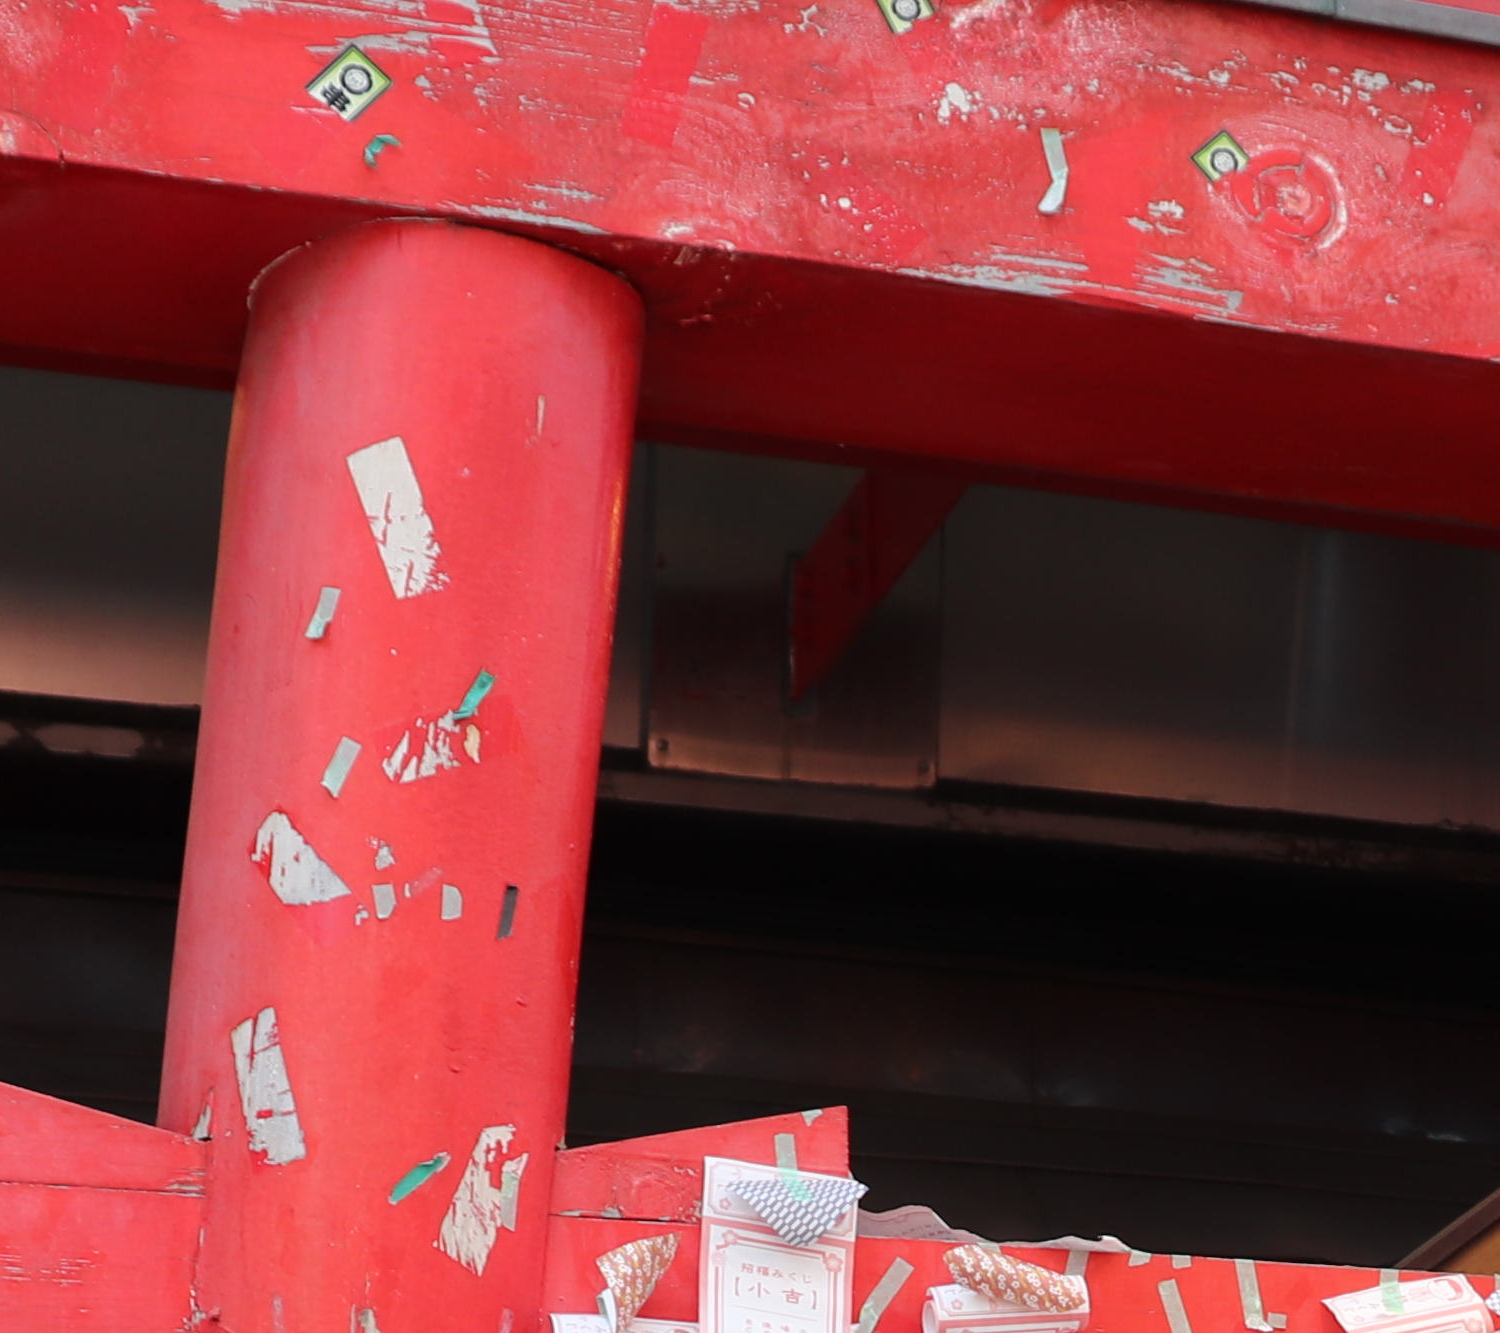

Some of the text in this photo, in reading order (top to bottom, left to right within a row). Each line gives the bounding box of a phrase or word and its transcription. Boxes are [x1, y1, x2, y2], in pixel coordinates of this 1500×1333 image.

[740, 1262, 812, 1284] 招福みくじ
